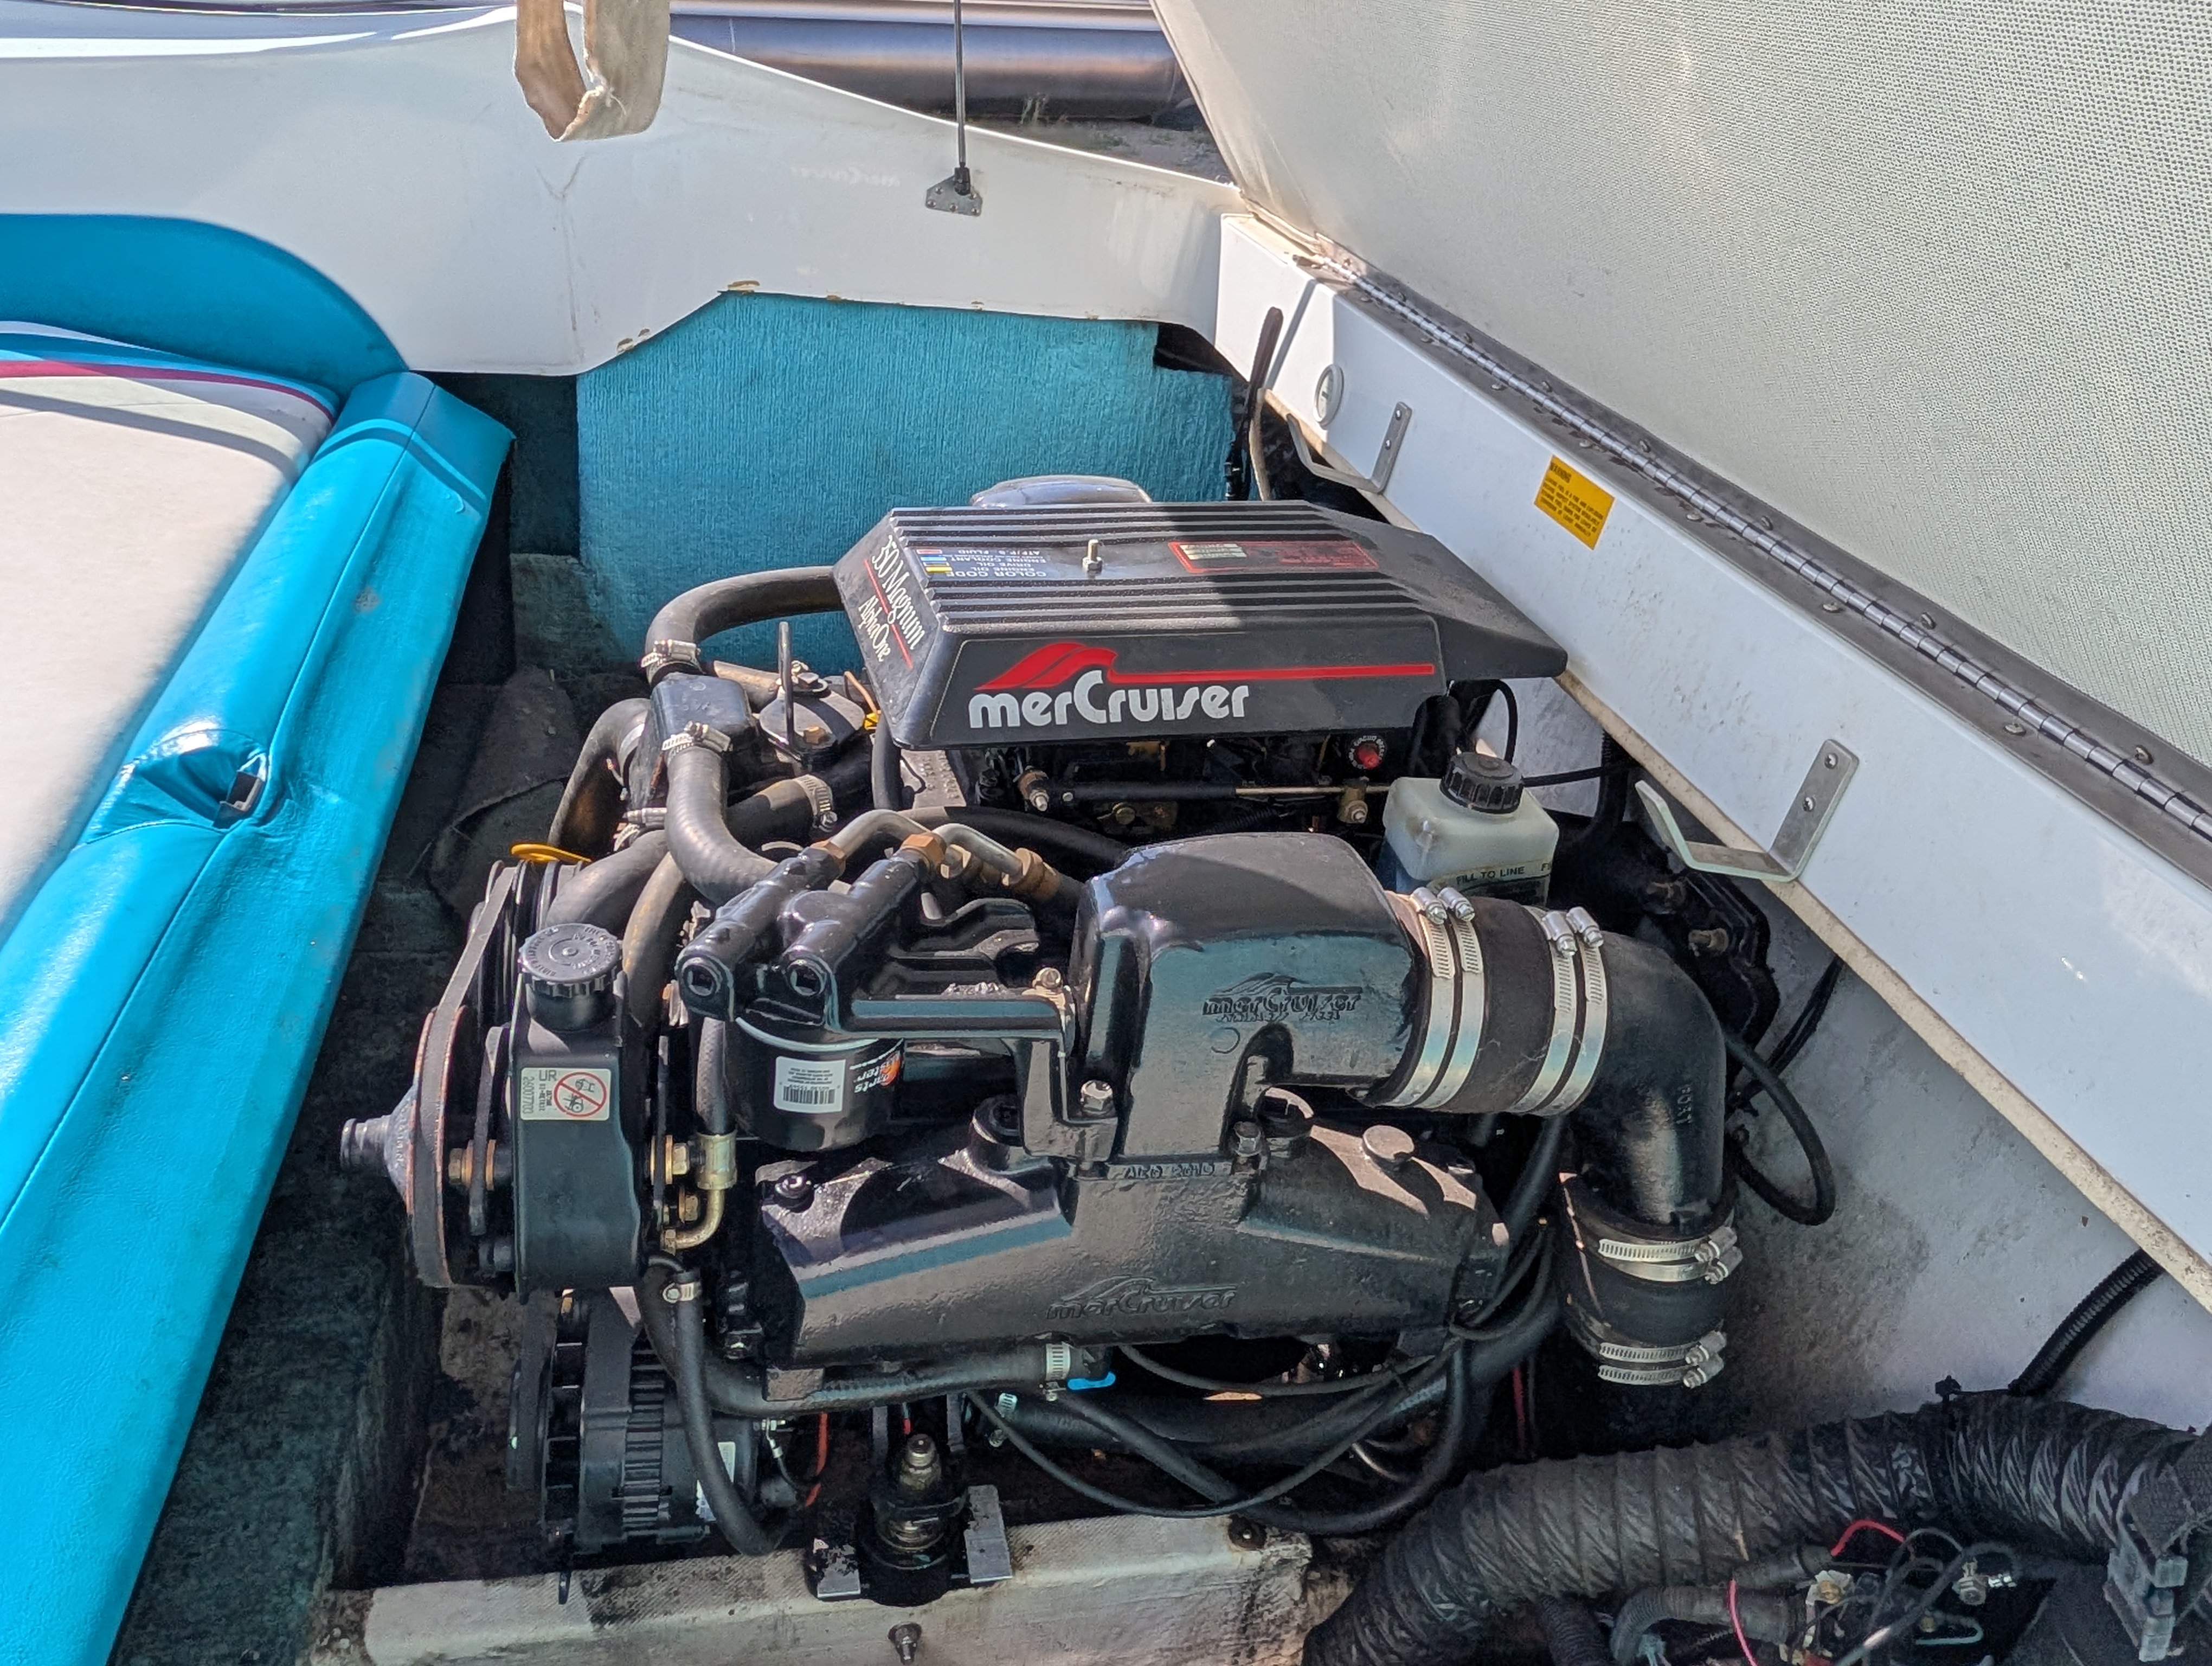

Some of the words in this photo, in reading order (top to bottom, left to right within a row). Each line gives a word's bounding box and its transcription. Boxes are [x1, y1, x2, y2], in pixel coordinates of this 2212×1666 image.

[872, 535, 899, 578] 350
[882, 560, 925, 650] Magnum
[969, 670, 1249, 728] merCruiser
[1456, 873, 1477, 885] FILL
[1481, 870, 1496, 879] TO
[1500, 866, 1525, 877] LINE
[539, 1069, 557, 1081] UR
